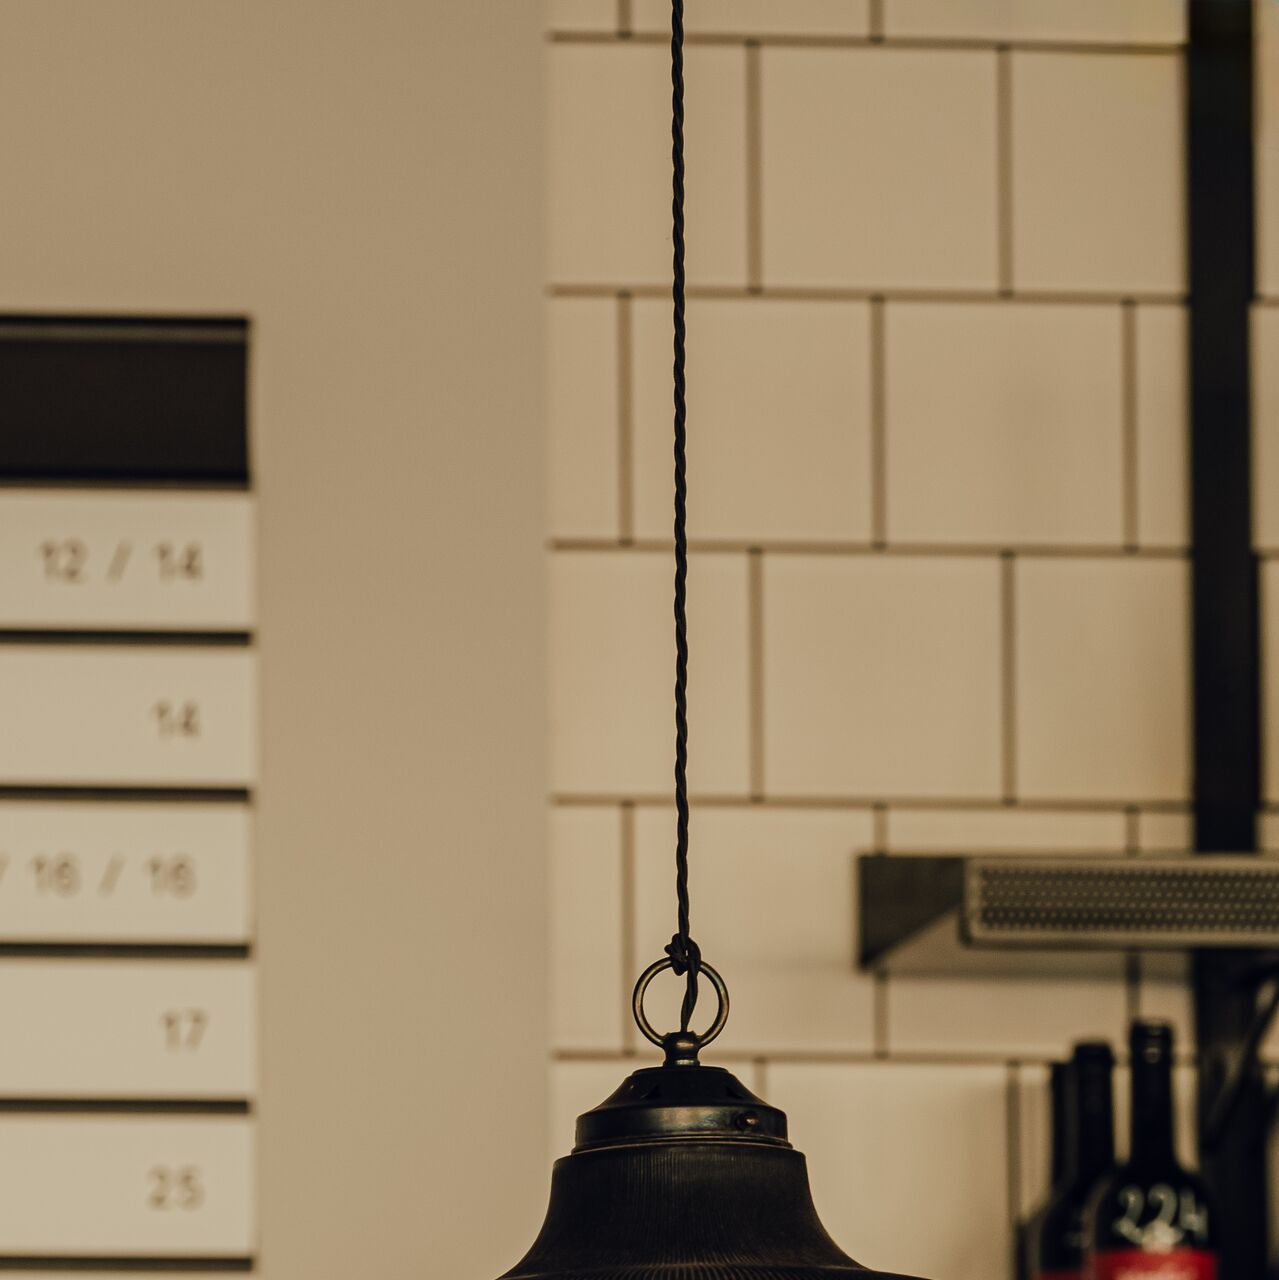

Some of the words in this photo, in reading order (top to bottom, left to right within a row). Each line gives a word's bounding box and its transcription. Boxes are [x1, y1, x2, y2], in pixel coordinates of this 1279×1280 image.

[38, 538, 90, 587] 12
[155, 542, 206, 586] 14
[151, 699, 204, 742] 14
[29, 853, 82, 900] 16
[146, 854, 199, 901] 16
[158, 1007, 213, 1054] 17
[146, 1163, 208, 1215] 25
